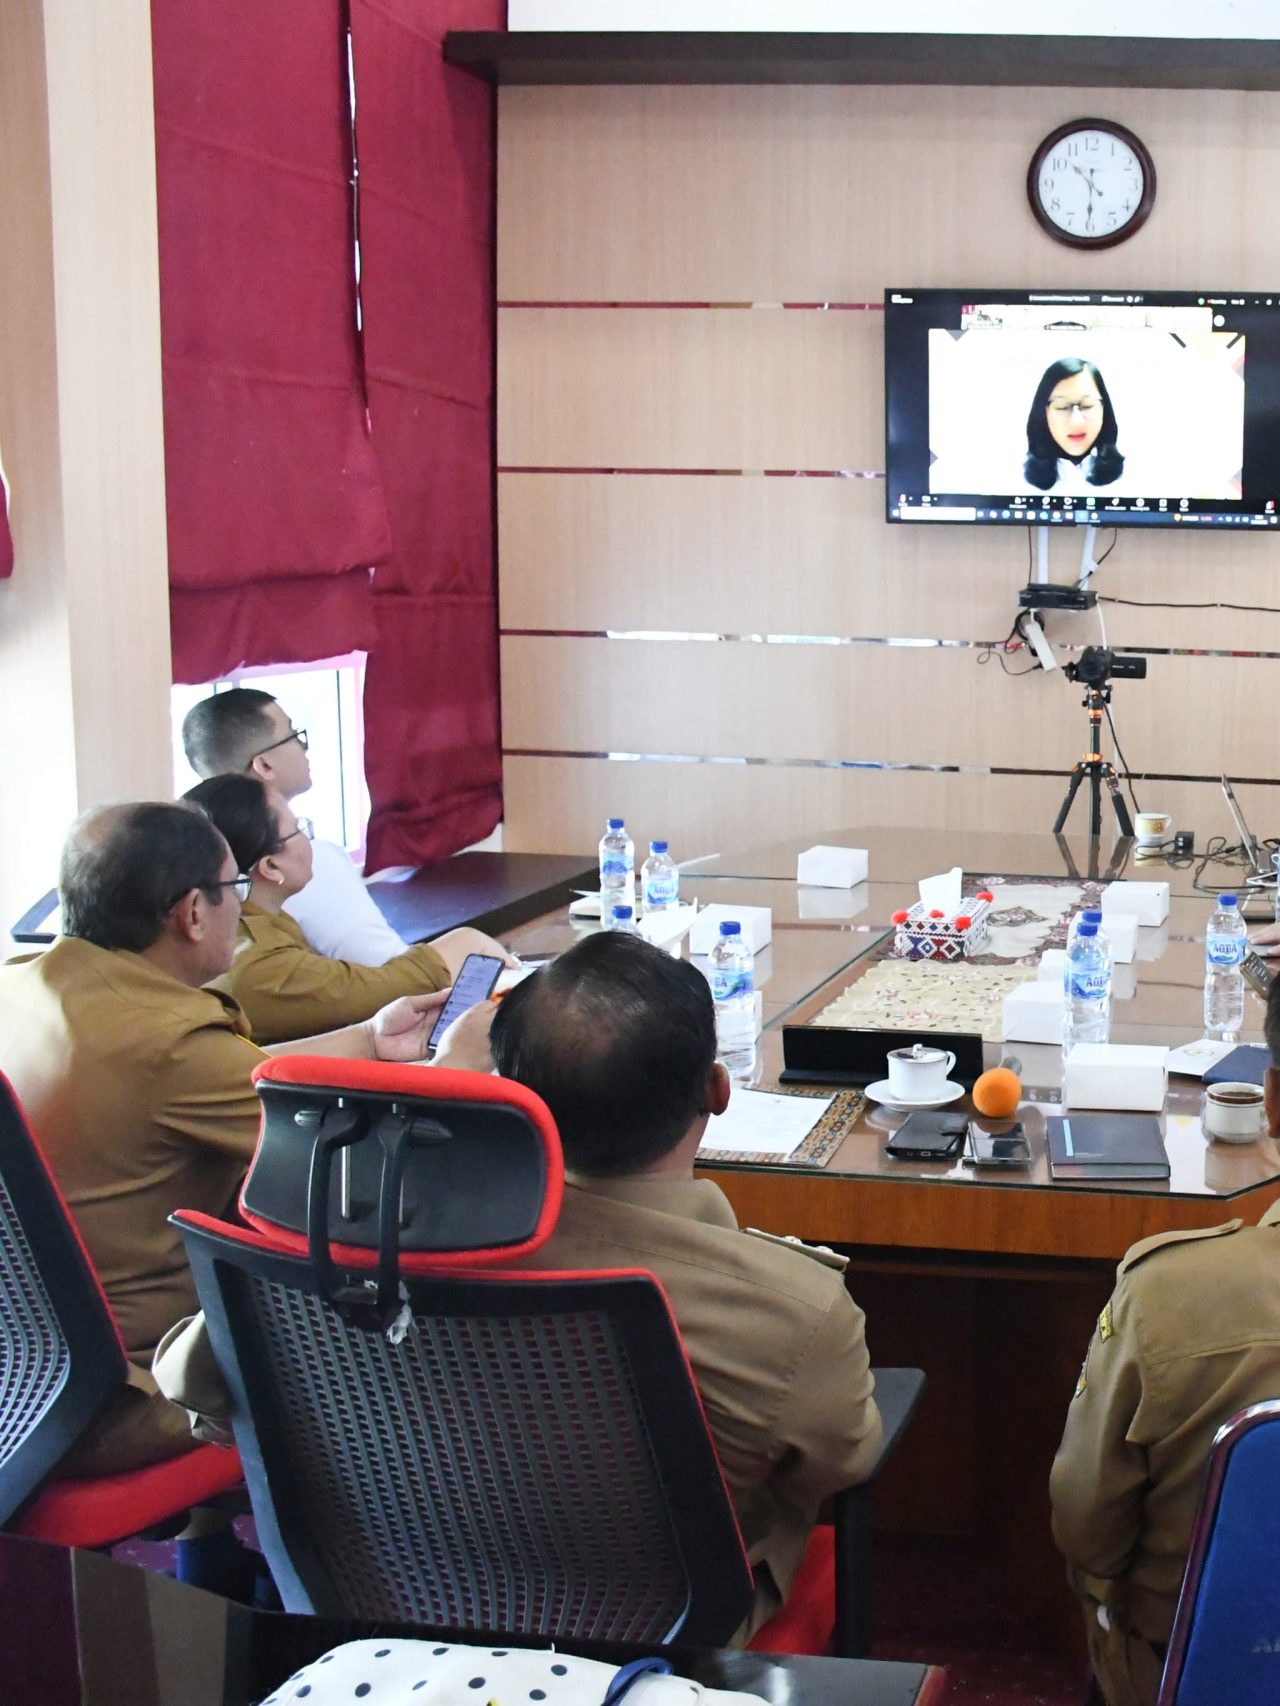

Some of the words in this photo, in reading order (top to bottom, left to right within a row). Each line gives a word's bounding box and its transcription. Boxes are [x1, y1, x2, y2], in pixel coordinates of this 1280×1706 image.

[1067, 143, 1078, 156] 11
[1085, 137, 1099, 151] 12
[1052, 158, 1068, 171] 10
[1123, 157, 1133, 171] 2
[1044, 178, 1055, 191] 9
[1129, 178, 1138, 191] 3
[1050, 198, 1061, 211] 8
[1121, 197, 1131, 211] 4
[1065, 211, 1076, 226] 7
[1084, 218, 1095, 232] 6
[1106, 211, 1117, 226] 5
[1213, 943, 1237, 954] AQUA
